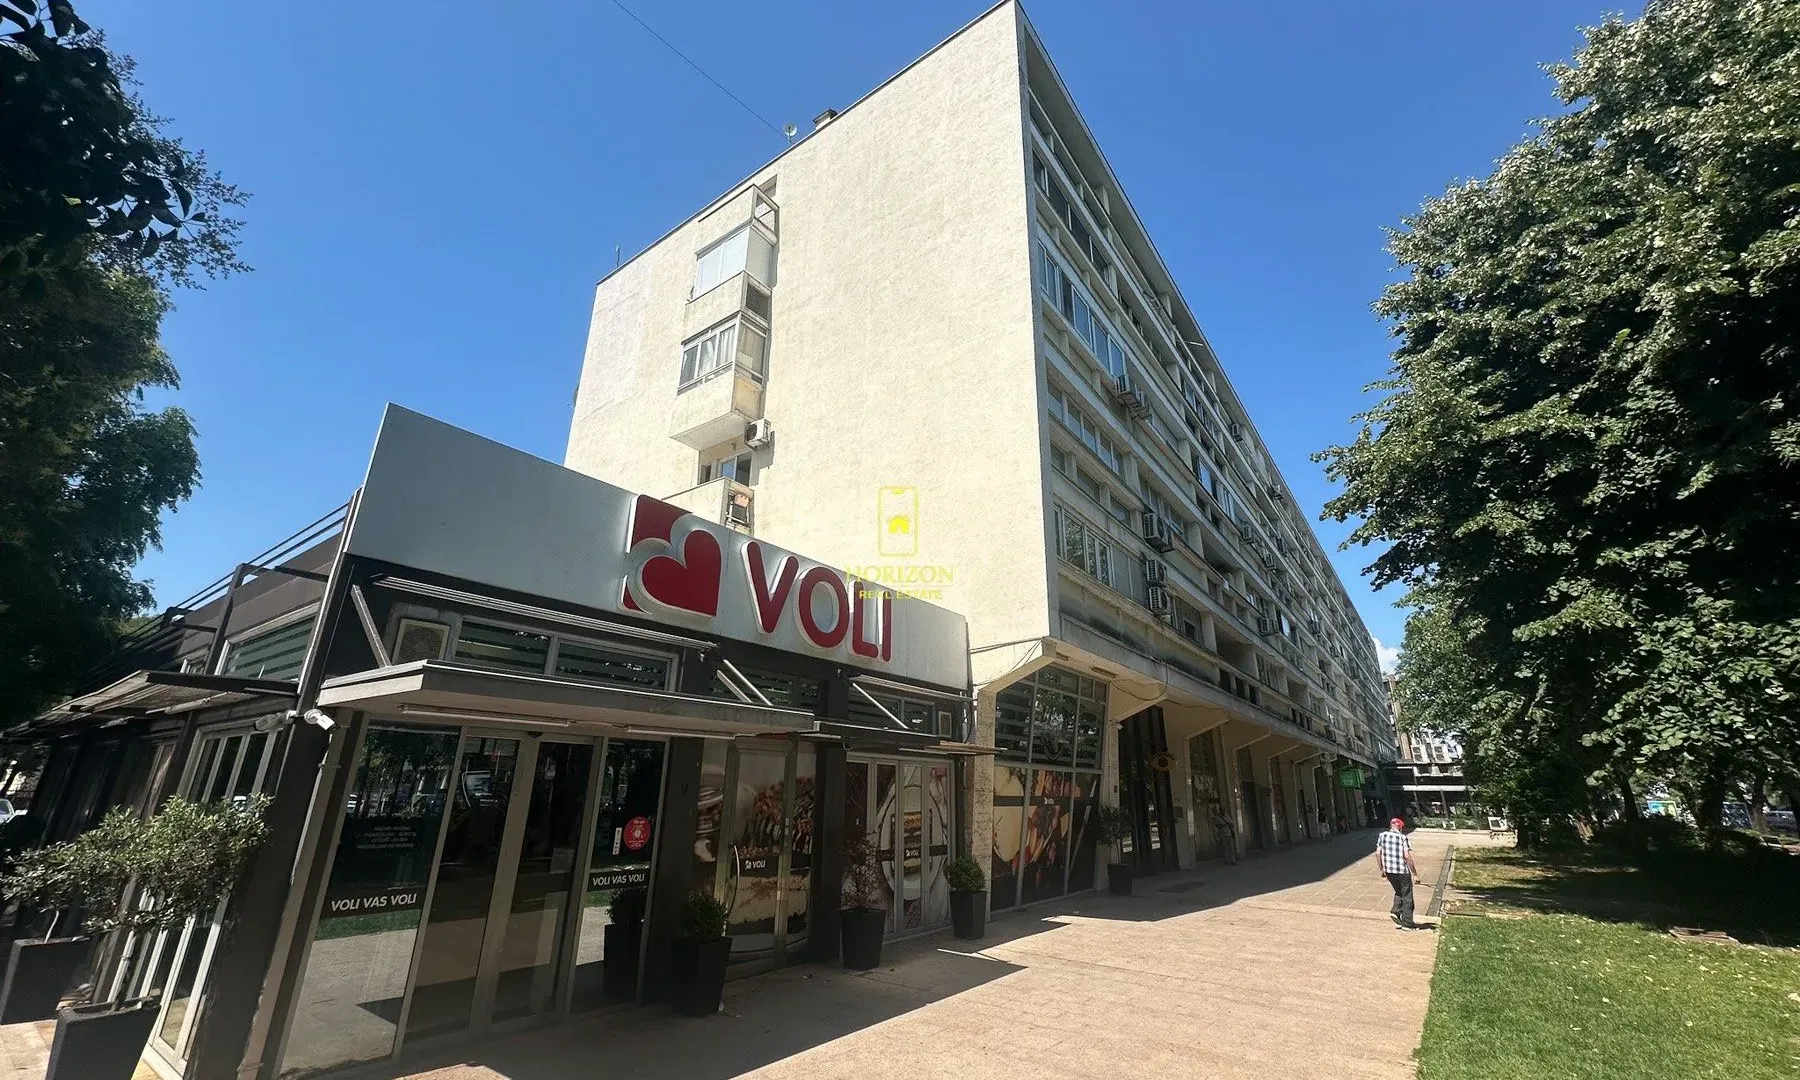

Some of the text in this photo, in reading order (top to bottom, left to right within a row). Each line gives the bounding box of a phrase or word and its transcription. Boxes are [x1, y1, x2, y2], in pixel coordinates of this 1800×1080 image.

[743, 541, 892, 662] VOLI
[592, 873, 645, 886] VOLI VAS VOLI
[331, 893, 418, 912] VOLI VAS VOLI
